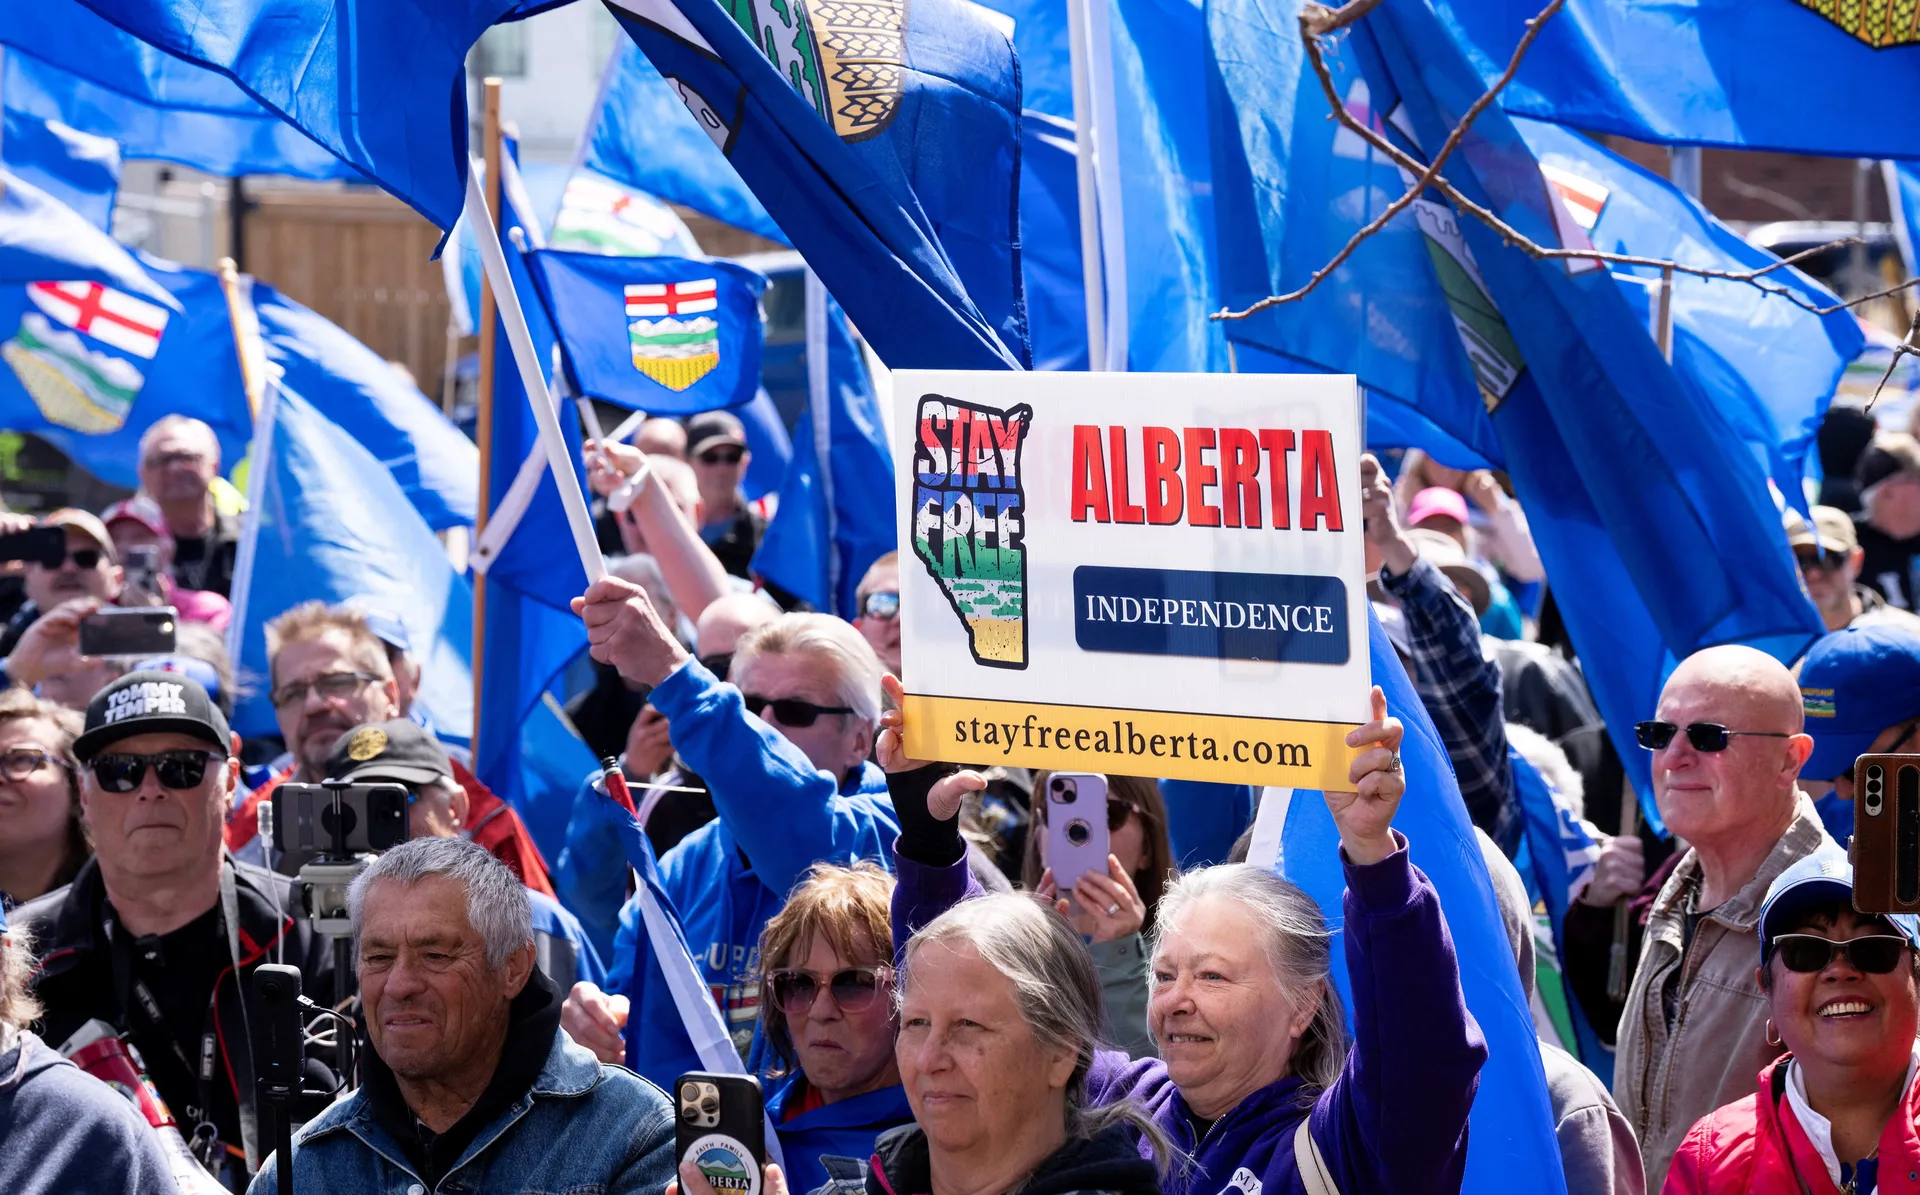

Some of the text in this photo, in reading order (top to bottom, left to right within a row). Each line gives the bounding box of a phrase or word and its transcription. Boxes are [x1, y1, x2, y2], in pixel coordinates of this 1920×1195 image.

[917, 400, 1026, 488] STAY
[1071, 425, 1344, 532] ALBERTA
[916, 490, 1023, 577] FREE
[1086, 595, 1334, 634] INDEPENDENCE
[104, 697, 187, 724] TEMPER
[108, 682, 184, 708] TOMMY
[955, 715, 1312, 767] stayfreealberta.com
[695, 1142, 744, 1158] FAITH FAMILY
[709, 1176, 749, 1190] BERTA
